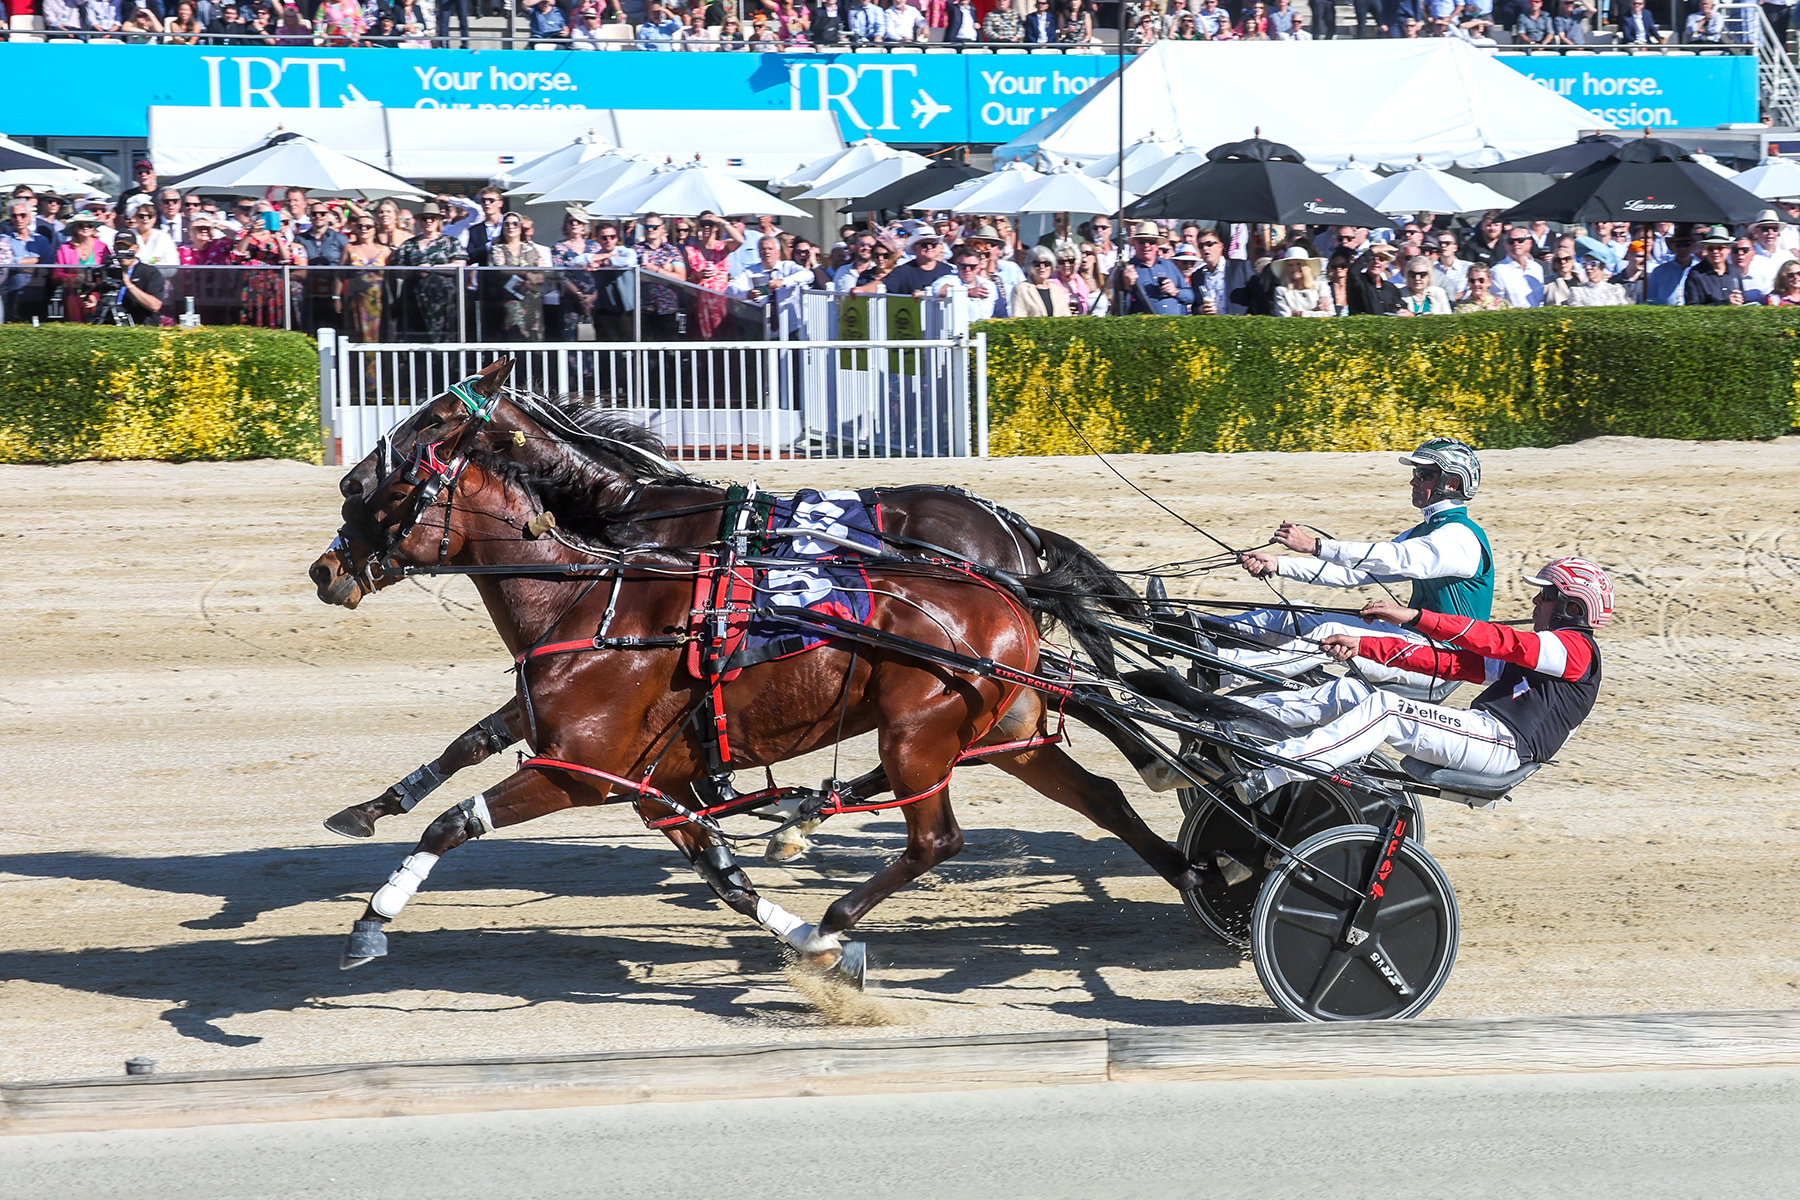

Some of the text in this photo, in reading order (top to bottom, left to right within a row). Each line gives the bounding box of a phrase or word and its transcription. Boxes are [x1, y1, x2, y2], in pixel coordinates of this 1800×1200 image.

[200, 56, 346, 108] IRT
[413, 66, 578, 91] Your horse.
[981, 70, 1047, 95] Your
[1583, 72, 1664, 96] horse.
[784, 63, 918, 130] IRT
[981, 102, 1035, 126] Our
